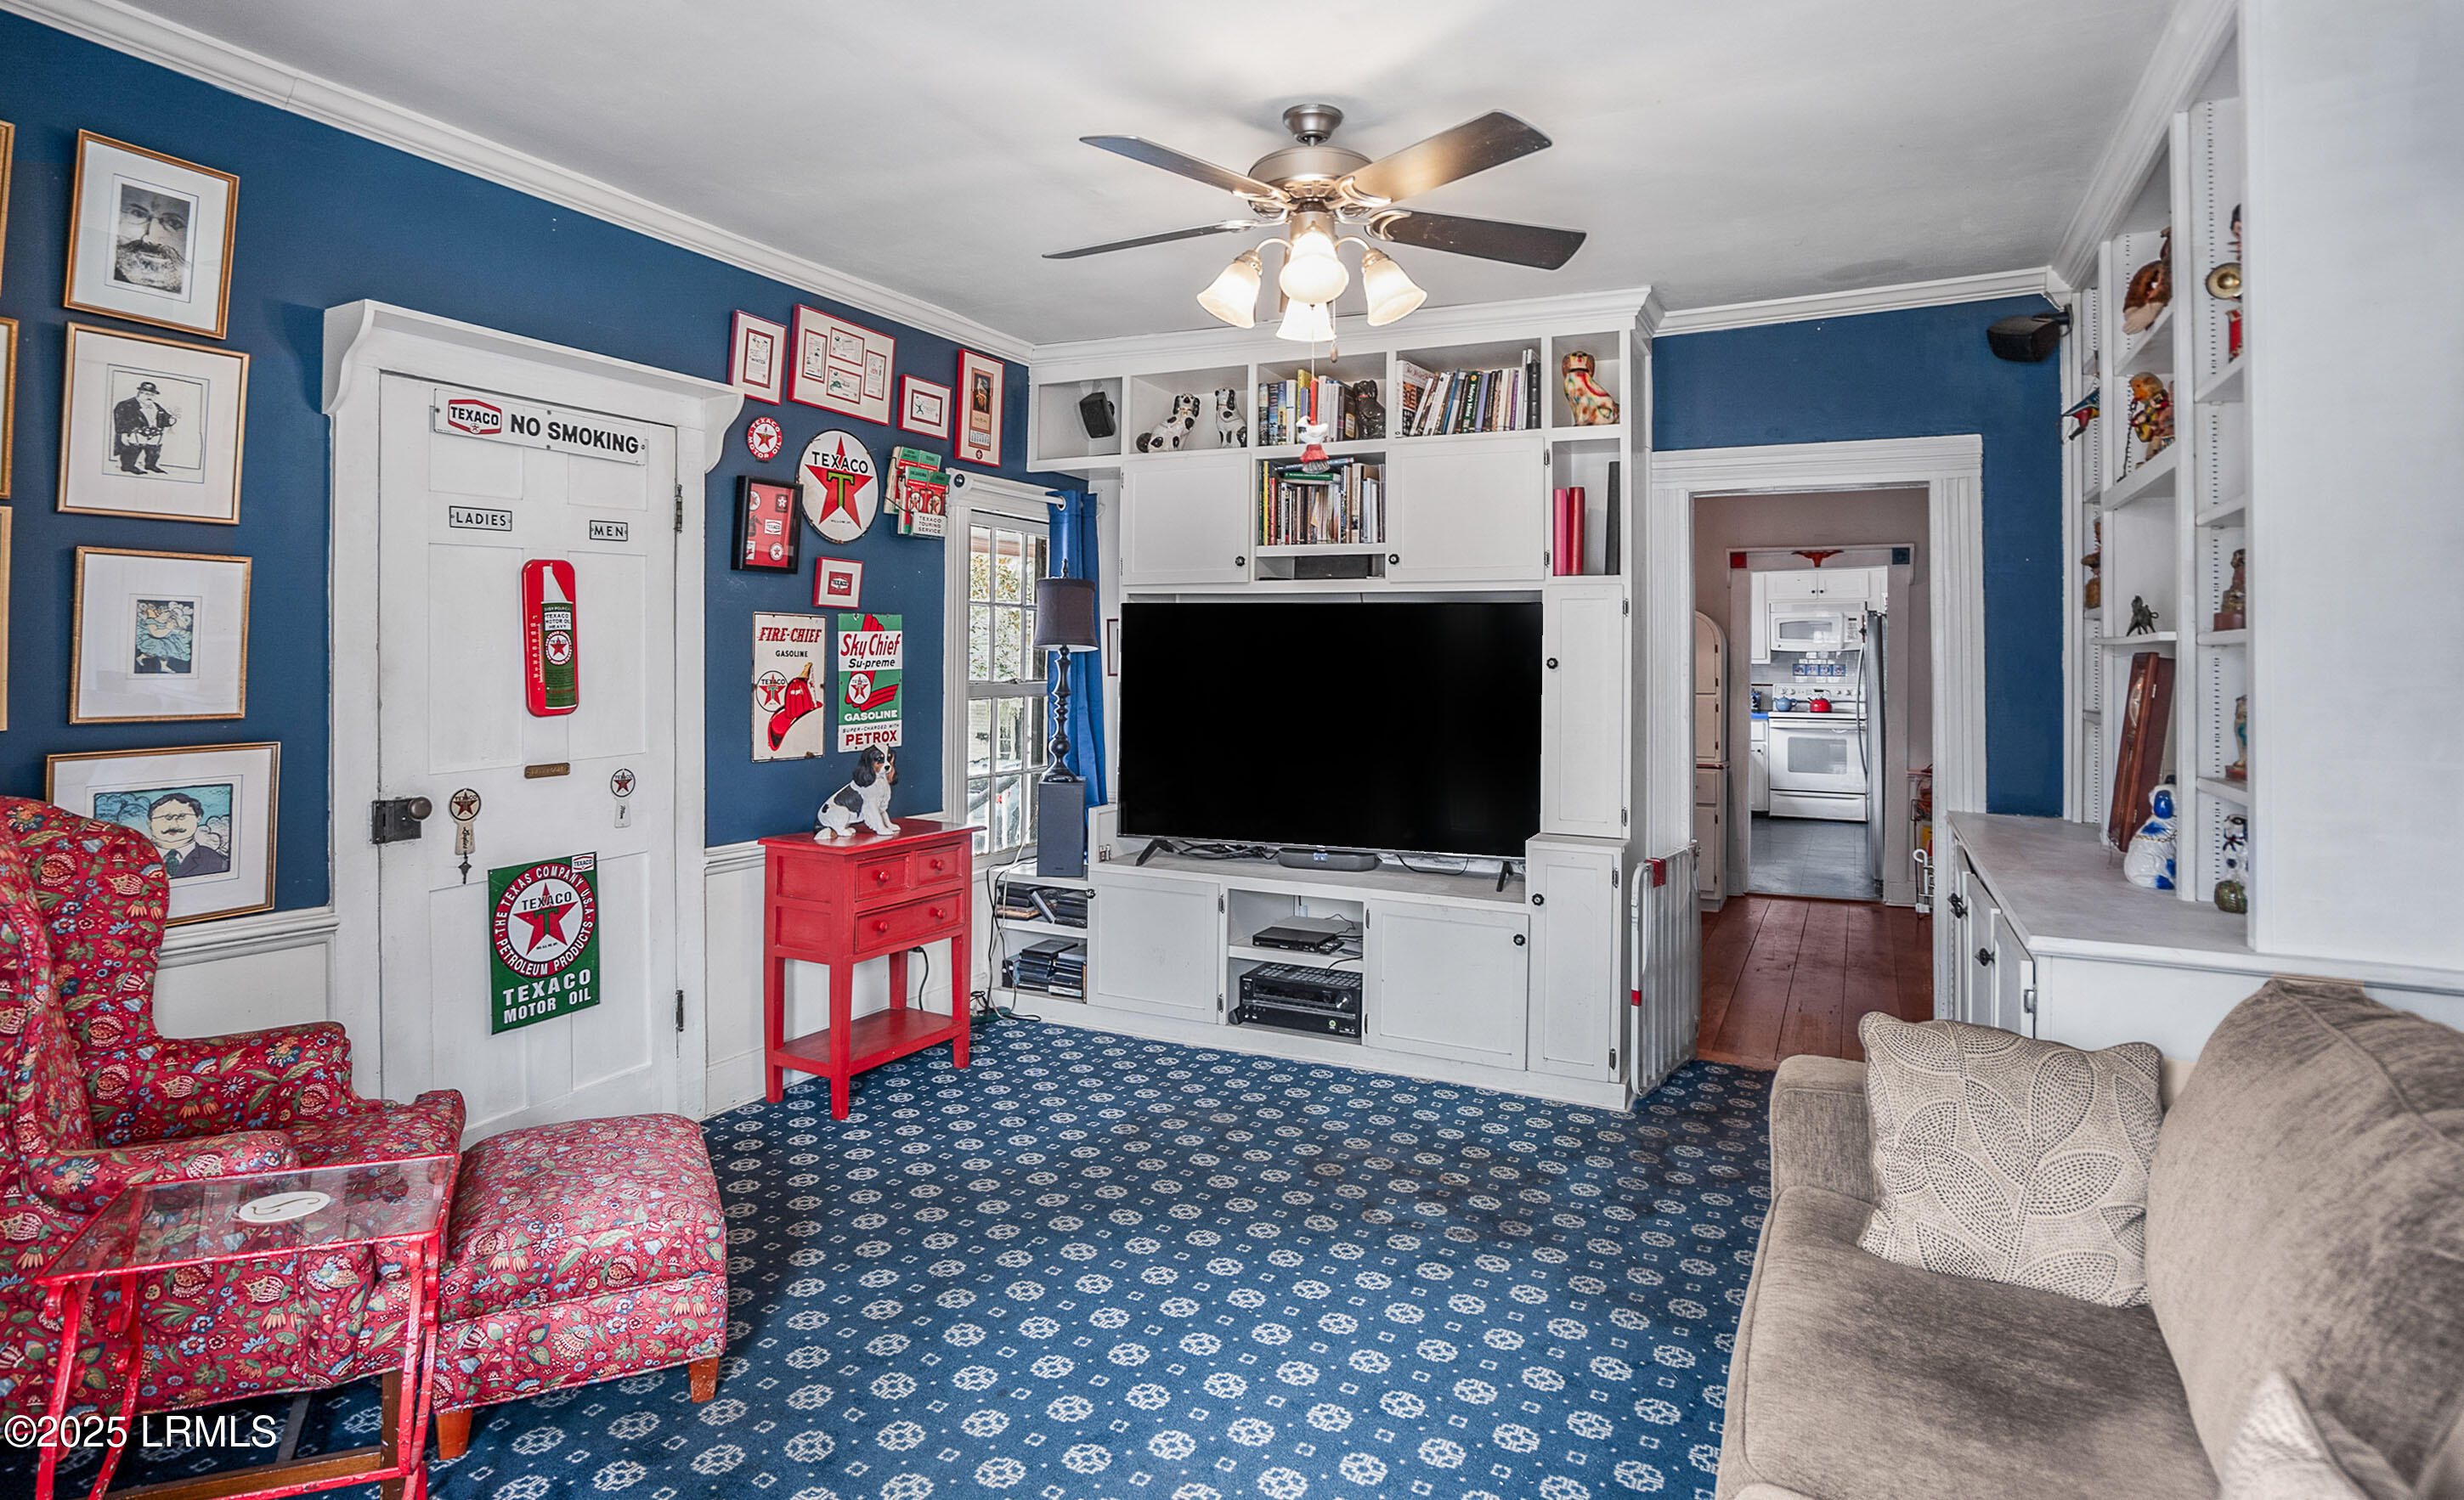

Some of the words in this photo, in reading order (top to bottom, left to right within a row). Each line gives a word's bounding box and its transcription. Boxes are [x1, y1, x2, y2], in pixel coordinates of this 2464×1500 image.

[450, 407, 499, 426] TEXACO
[750, 418, 780, 432] TEXACO
[511, 414, 540, 437] NO
[547, 422, 638, 454] SMOKING
[749, 436, 769, 459] MOTOR
[771, 442, 782, 454] OIL
[812, 451, 868, 474] TEXACO
[455, 511, 506, 527] LADIES
[594, 526, 624, 537] MEN
[758, 627, 822, 643] FIRE-CHIEF
[840, 633, 867, 659] Sky
[869, 634, 901, 657] Chief
[844, 710, 898, 722] GASOLINE
[842, 724, 887, 733] SUPER-CHARGED
[845, 730, 897, 746] PETROX
[574, 859, 592, 867] TEXACO
[535, 866, 584, 888] COMPANY
[500, 873, 532, 906] TEXAS
[522, 891, 572, 911] TEXACO
[495, 911, 507, 934] THE
[496, 938, 548, 976] PETROLEUM
[553, 921, 594, 972] PRODUCTS
[502, 967, 591, 1007] TEXACO
[503, 997, 557, 1024] MOTOR
[568, 988, 592, 1006] OIL
